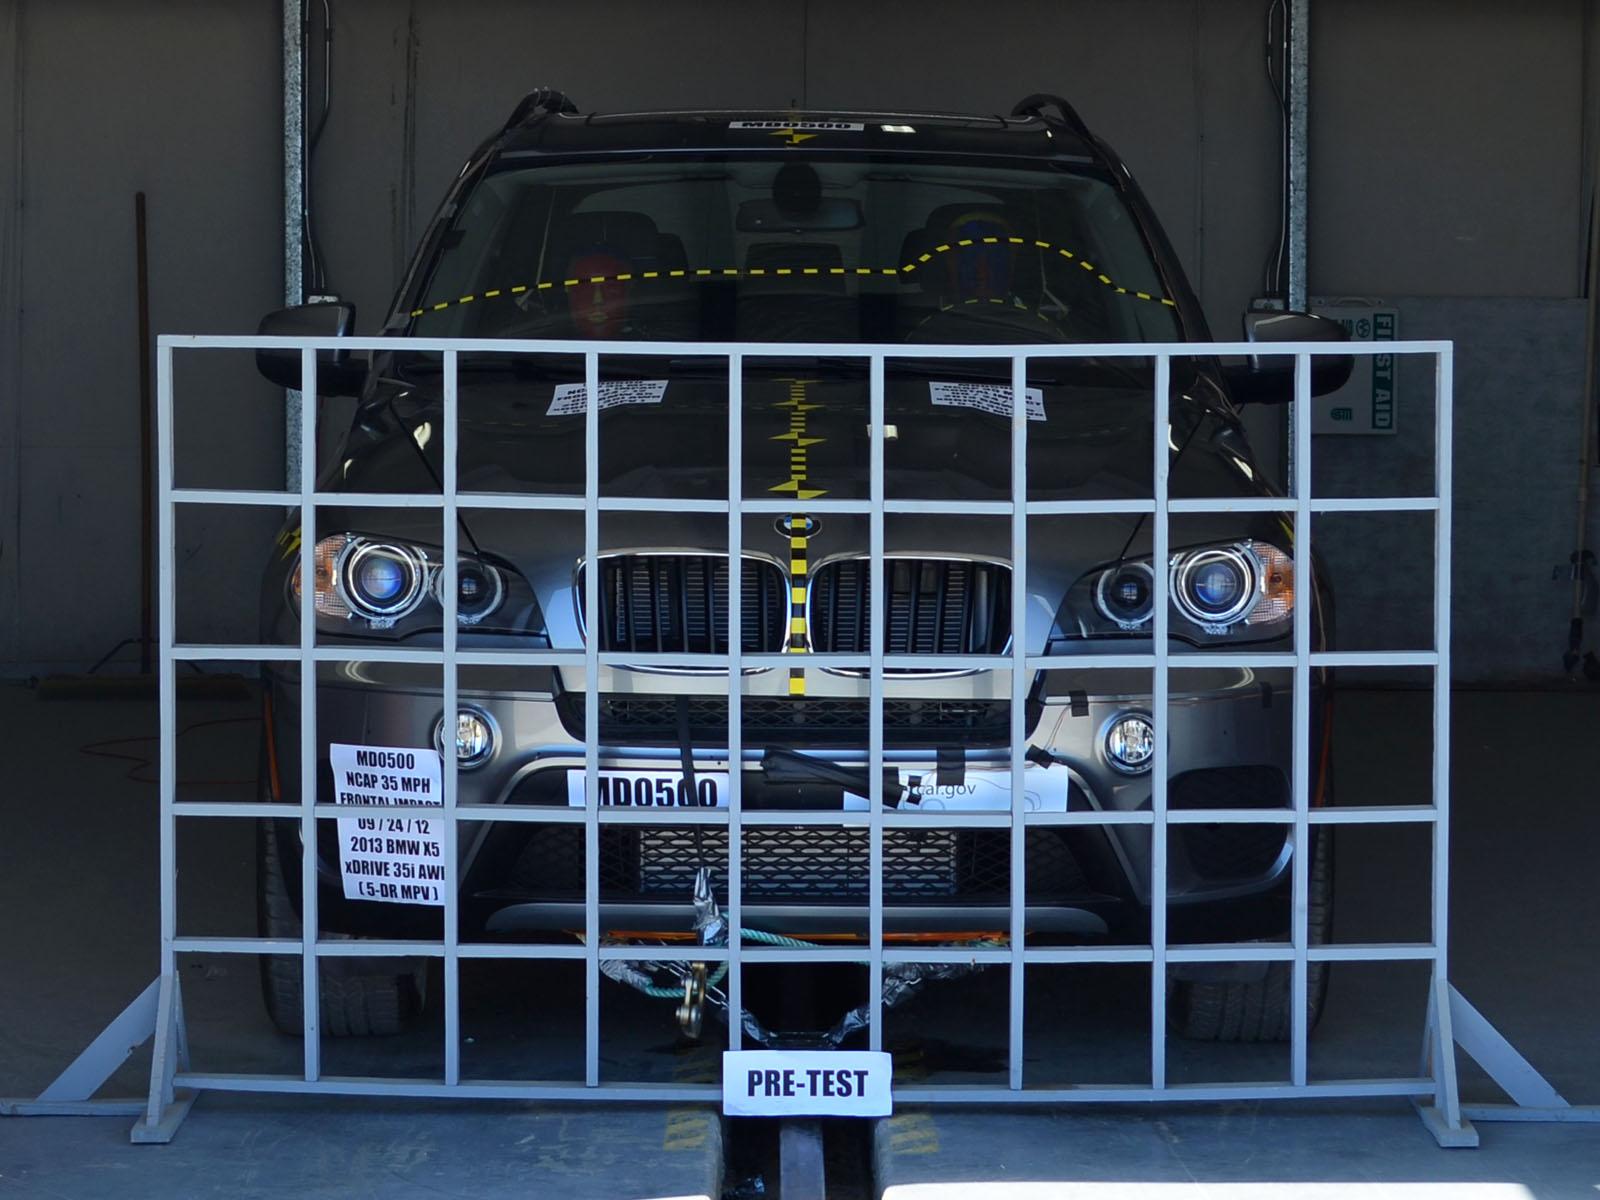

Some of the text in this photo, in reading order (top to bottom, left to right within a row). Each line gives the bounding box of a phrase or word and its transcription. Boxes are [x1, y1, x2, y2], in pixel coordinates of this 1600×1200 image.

[1375, 315, 1392, 429] FIST AID
[356, 750, 415, 770] MD0500
[346, 771, 431, 794] NCAP 35 MPH
[387, 818, 404, 832] 24
[415, 819, 430, 834] 12
[350, 836, 440, 857] 2013 BMW X5
[345, 859, 390, 877] xDRIVE
[393, 862, 415, 879] 35i
[366, 882, 398, 898] 5-DR
[400, 884, 430, 900] MPV
[747, 1069, 869, 1097] PRE-TEST
